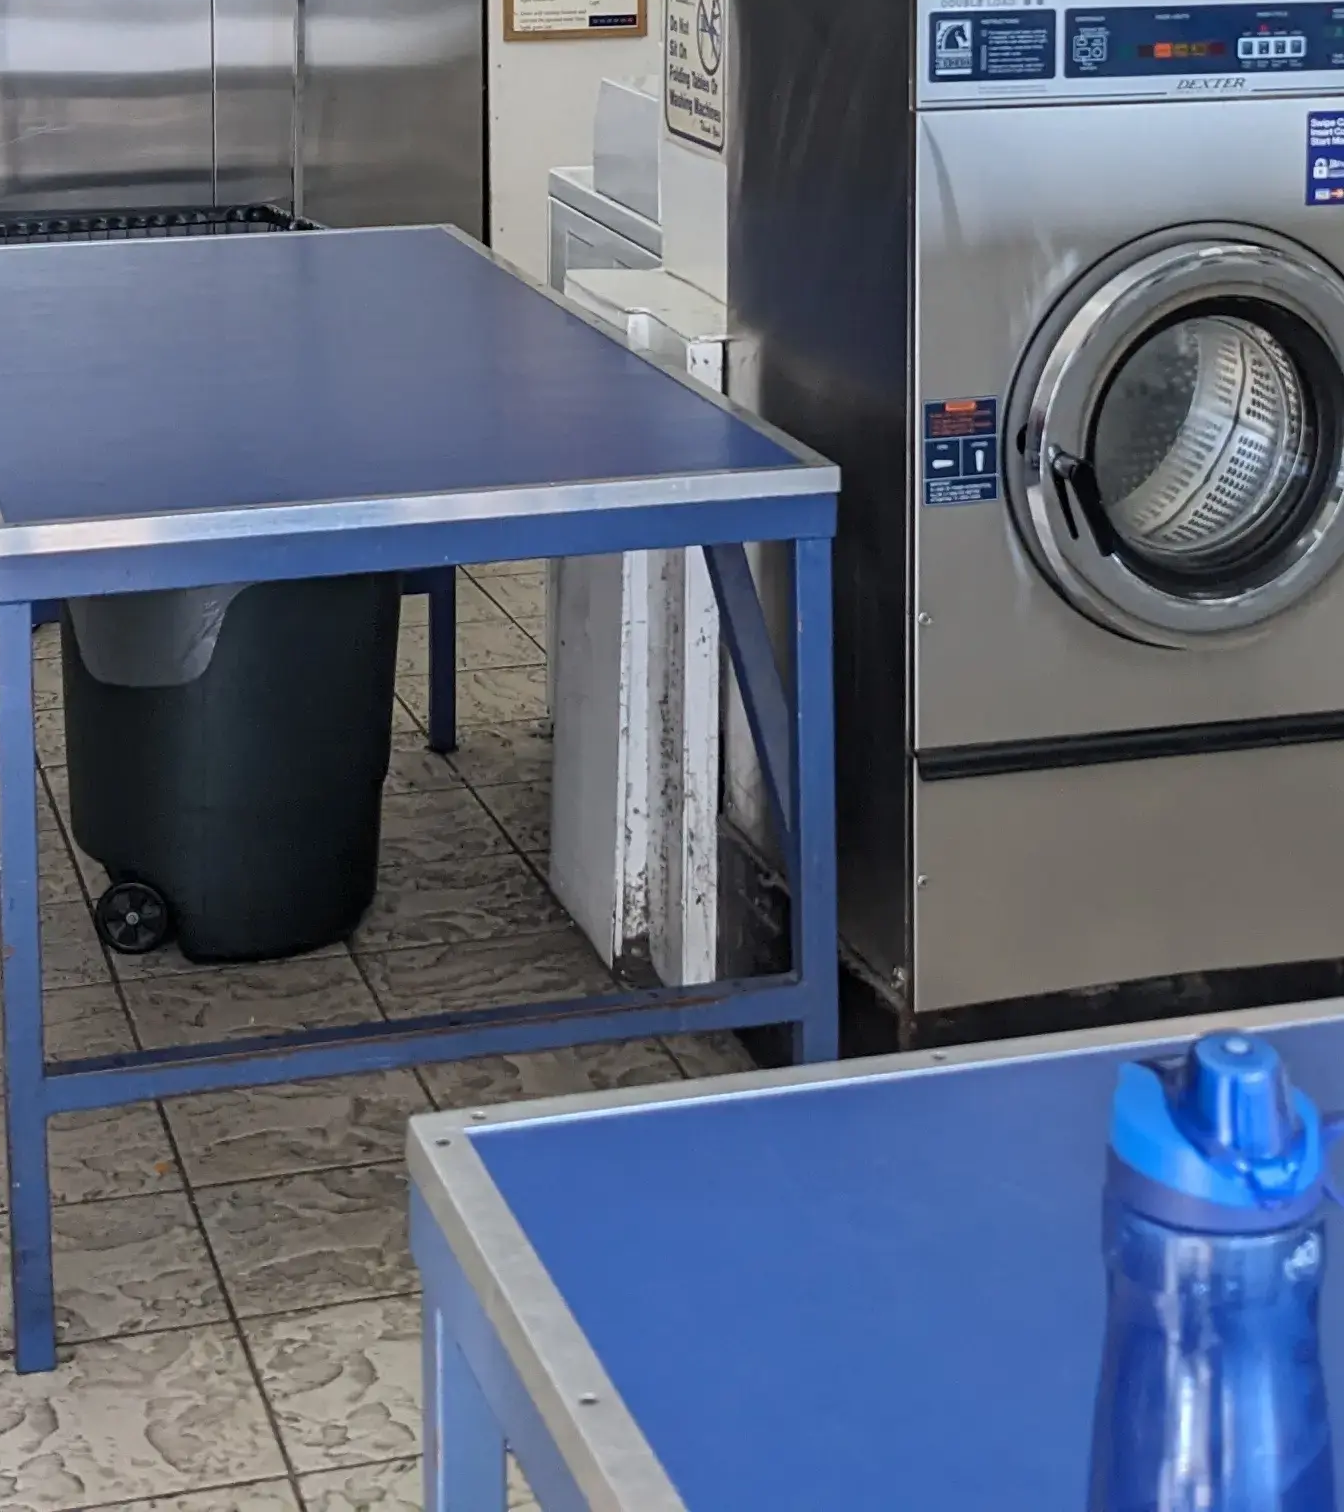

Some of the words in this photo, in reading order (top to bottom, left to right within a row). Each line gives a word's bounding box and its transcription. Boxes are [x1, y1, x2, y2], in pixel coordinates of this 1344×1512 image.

[670, 15, 677, 32] Do
[679, 17, 689, 35] Not
[670, 39, 678, 57] Sit
[679, 42, 687, 60] On
[670, 64, 690, 90] Folding
[691, 71, 709, 93] Tables
[1176, 77, 1246, 89] DEXTER
[669, 89, 693, 116] Washing
[694, 96, 721, 123] Machines
[1310, 118, 1336, 127] Swipe
[1310, 128, 1333, 136] Insert
[1310, 137, 1331, 146] Start
